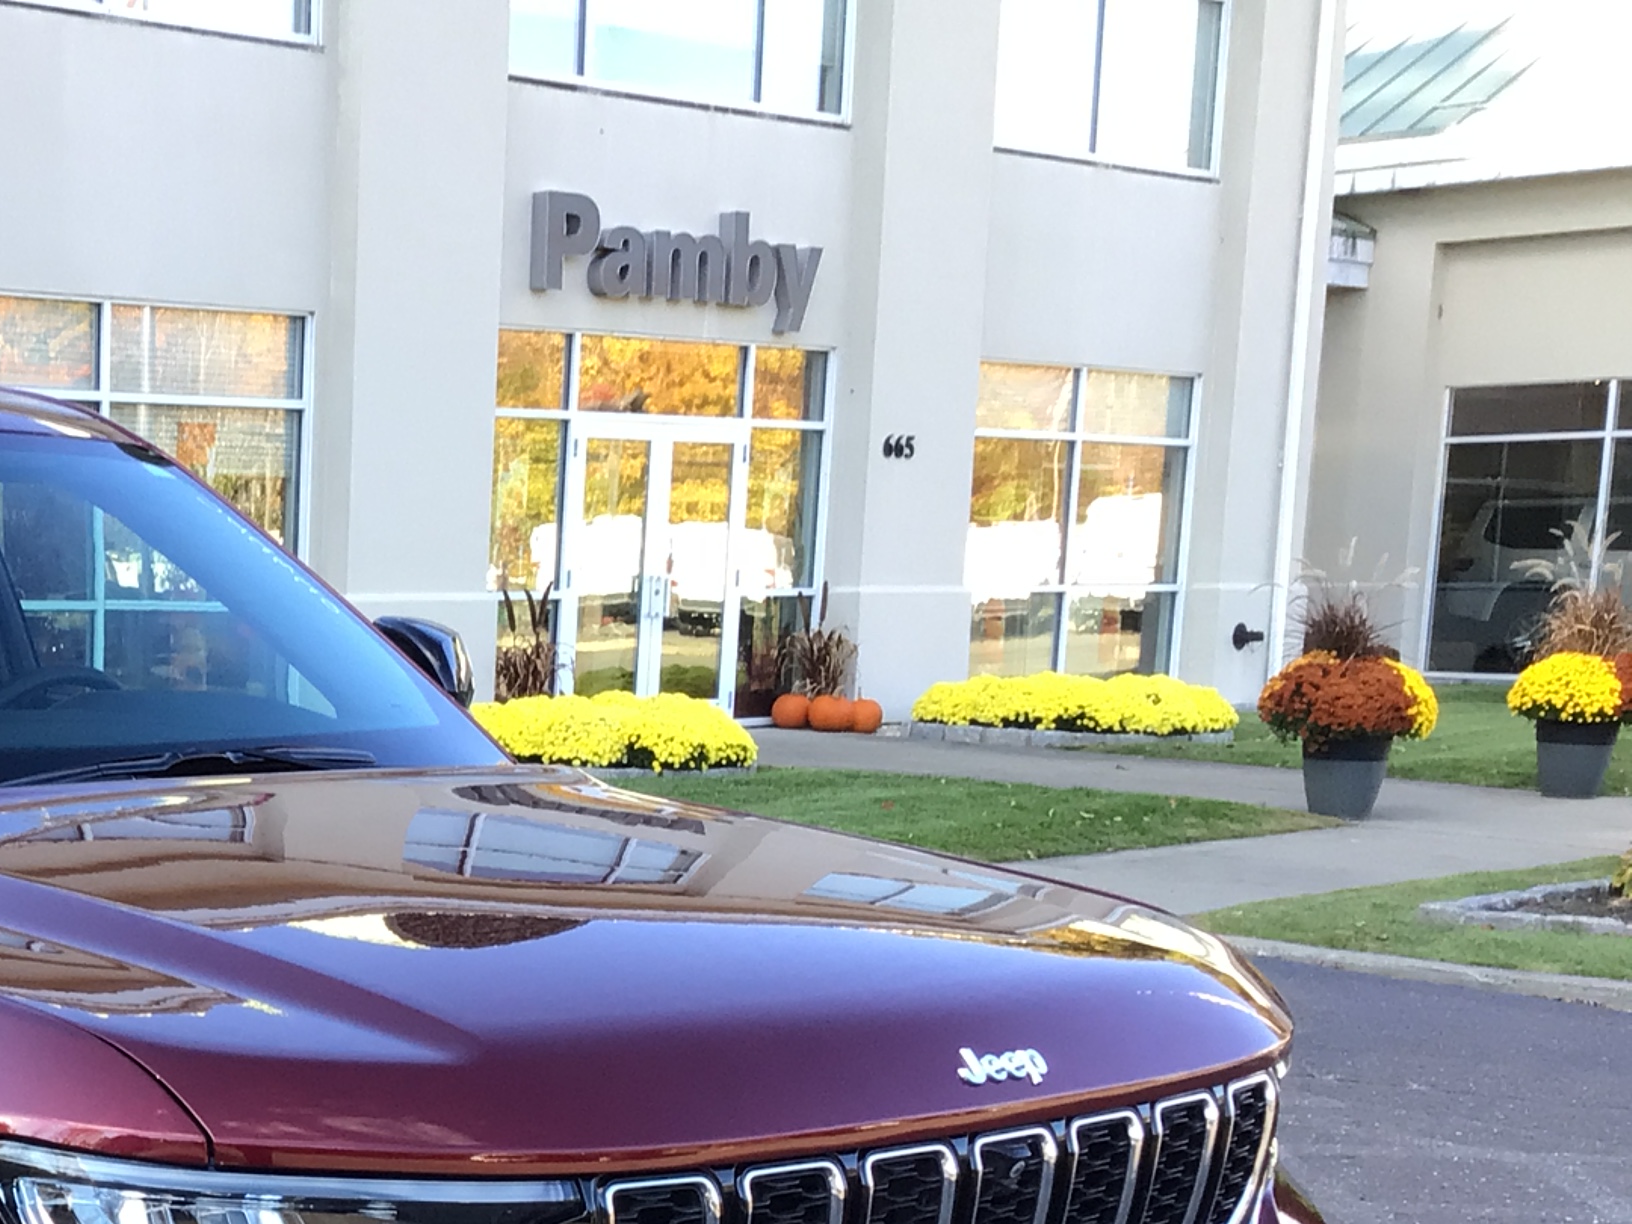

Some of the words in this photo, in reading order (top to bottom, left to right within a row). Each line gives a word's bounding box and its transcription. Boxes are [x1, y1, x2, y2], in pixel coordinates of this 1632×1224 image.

[529, 190, 824, 335] Pamby
[883, 434, 916, 459] 665
[956, 1047, 1048, 1085] Jeep
